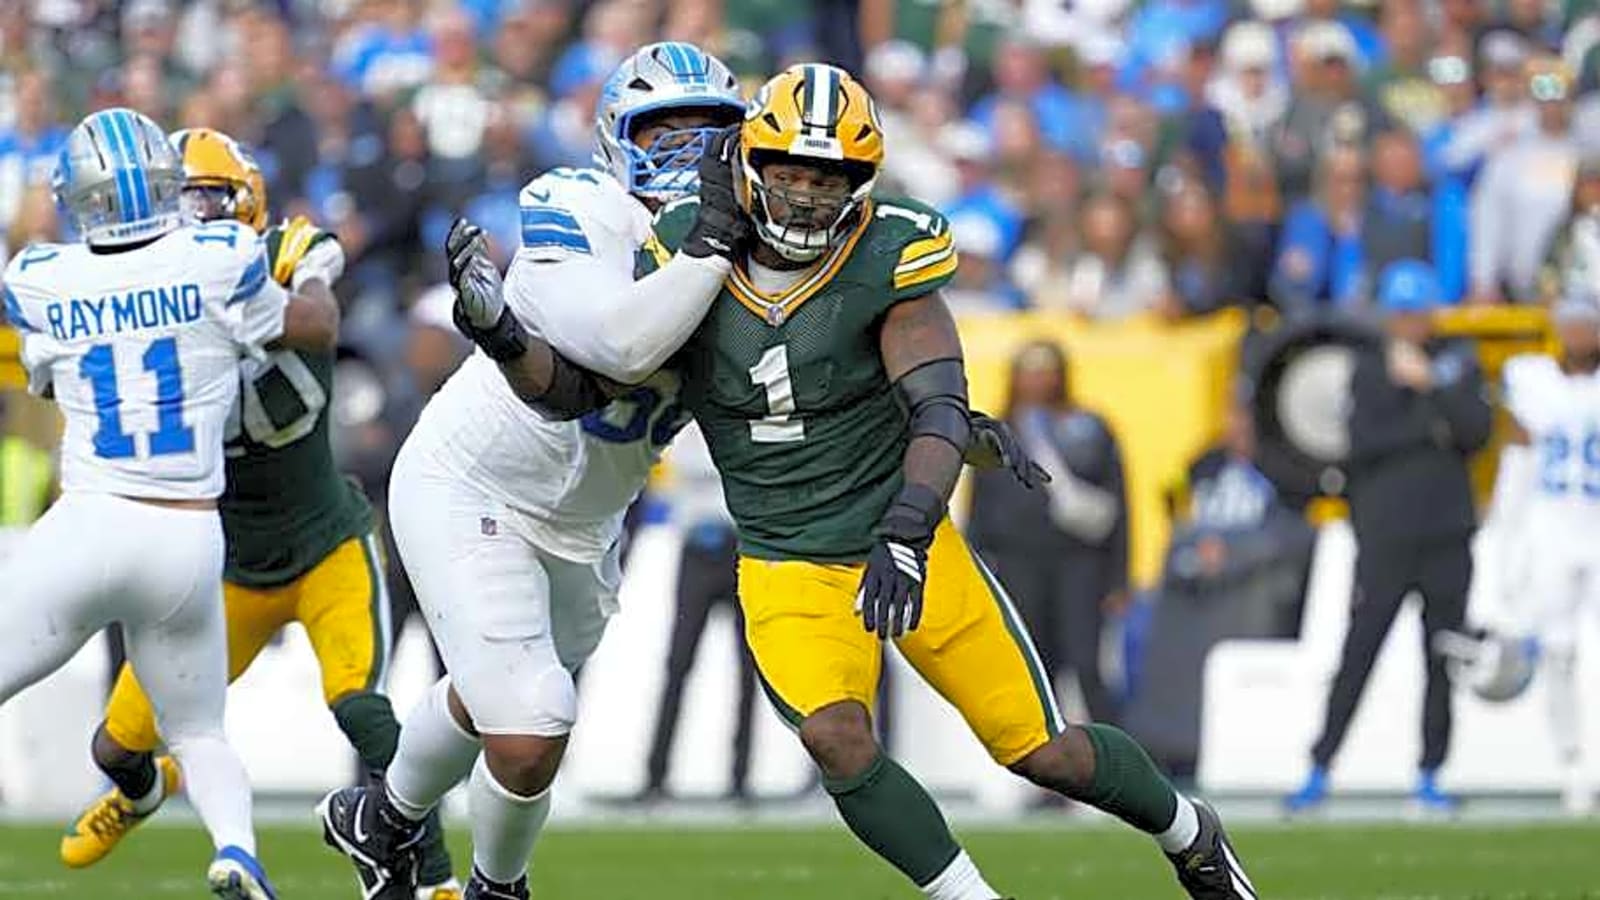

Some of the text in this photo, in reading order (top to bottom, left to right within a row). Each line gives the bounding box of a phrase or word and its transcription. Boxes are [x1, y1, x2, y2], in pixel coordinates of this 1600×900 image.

[193, 224, 239, 248] 11
[876, 204, 931, 231] 1
[47, 284, 201, 340] RAYMOND
[79, 337, 195, 458] 11
[748, 344, 805, 442] 1
